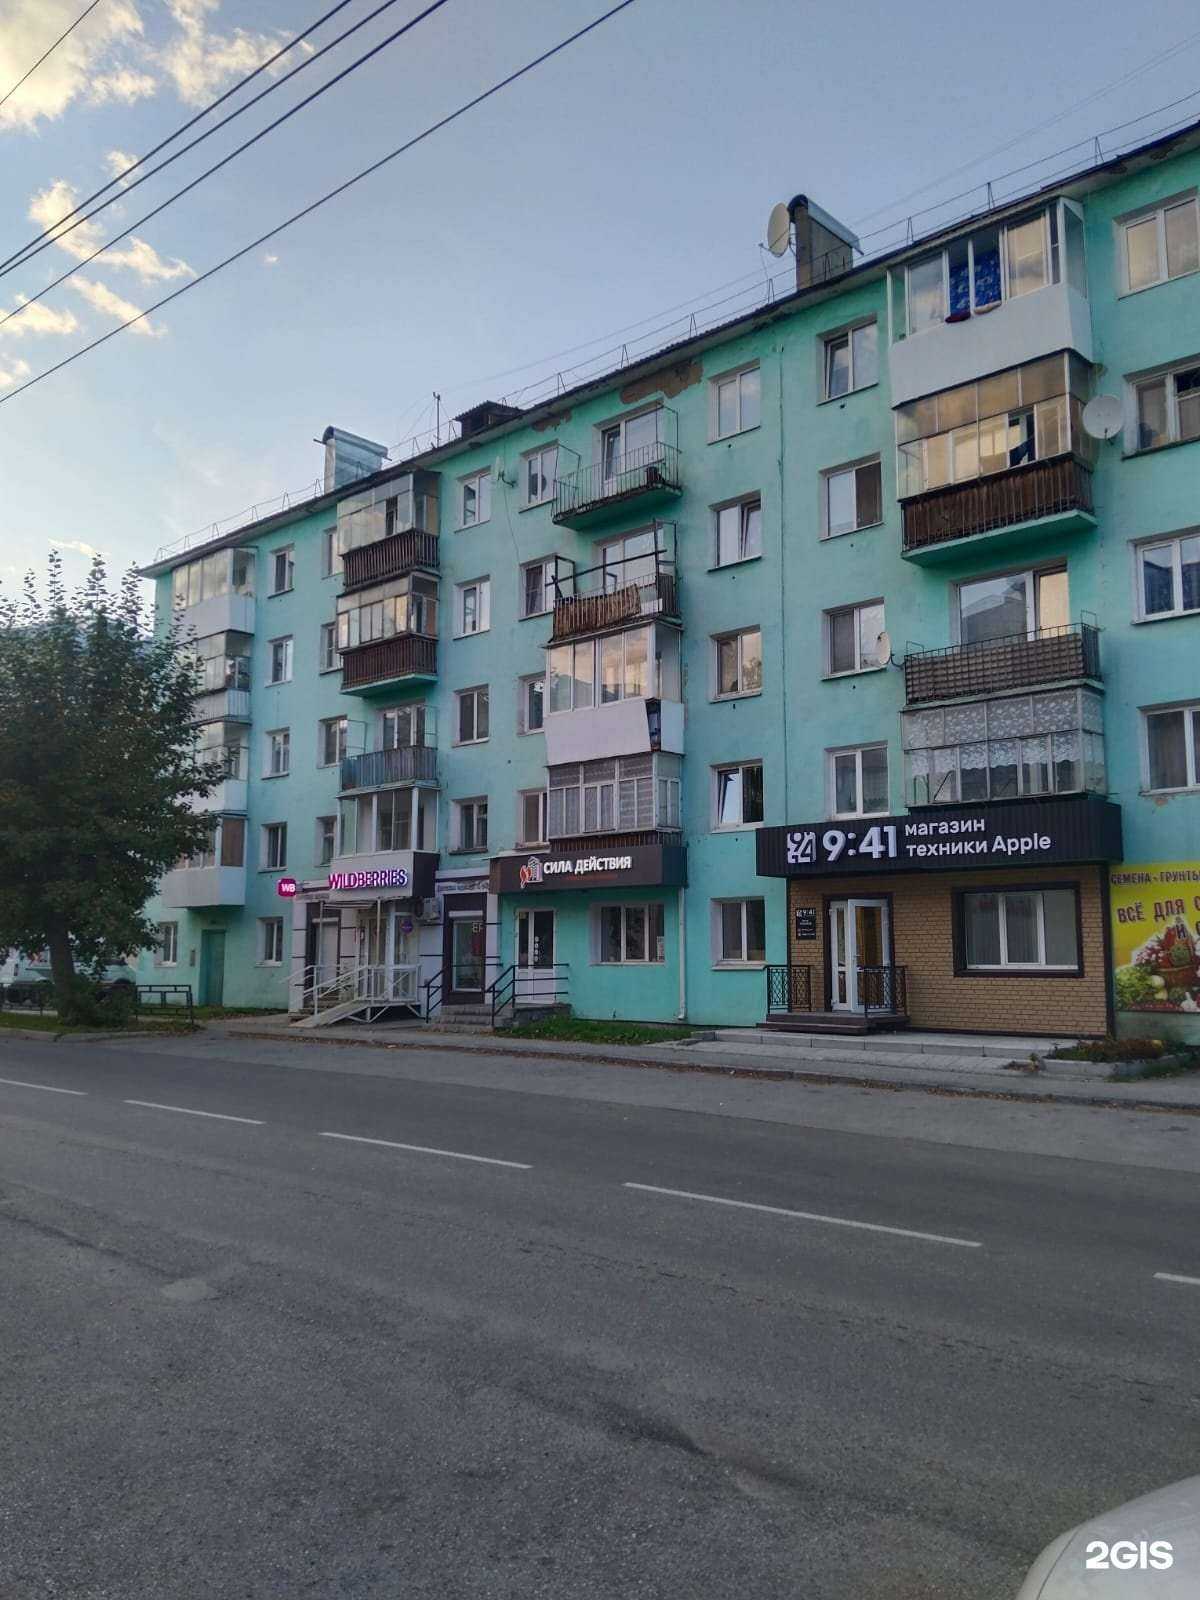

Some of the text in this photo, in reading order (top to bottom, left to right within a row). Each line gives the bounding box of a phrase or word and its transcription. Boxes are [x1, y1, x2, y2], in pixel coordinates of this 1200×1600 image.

[904, 818, 985, 836] магазин
[822, 825, 897, 862] 9:41
[906, 833, 1051, 857] техники Apple
[543, 856, 632, 875] СИЛА ДЕЙСТВИЯ
[281, 883, 296, 892] WB
[328, 869, 408, 889] WILDBERRIES
[1117, 902, 1145, 923] ВСЁ
[1154, 899, 1185, 922] ДЛЯ
